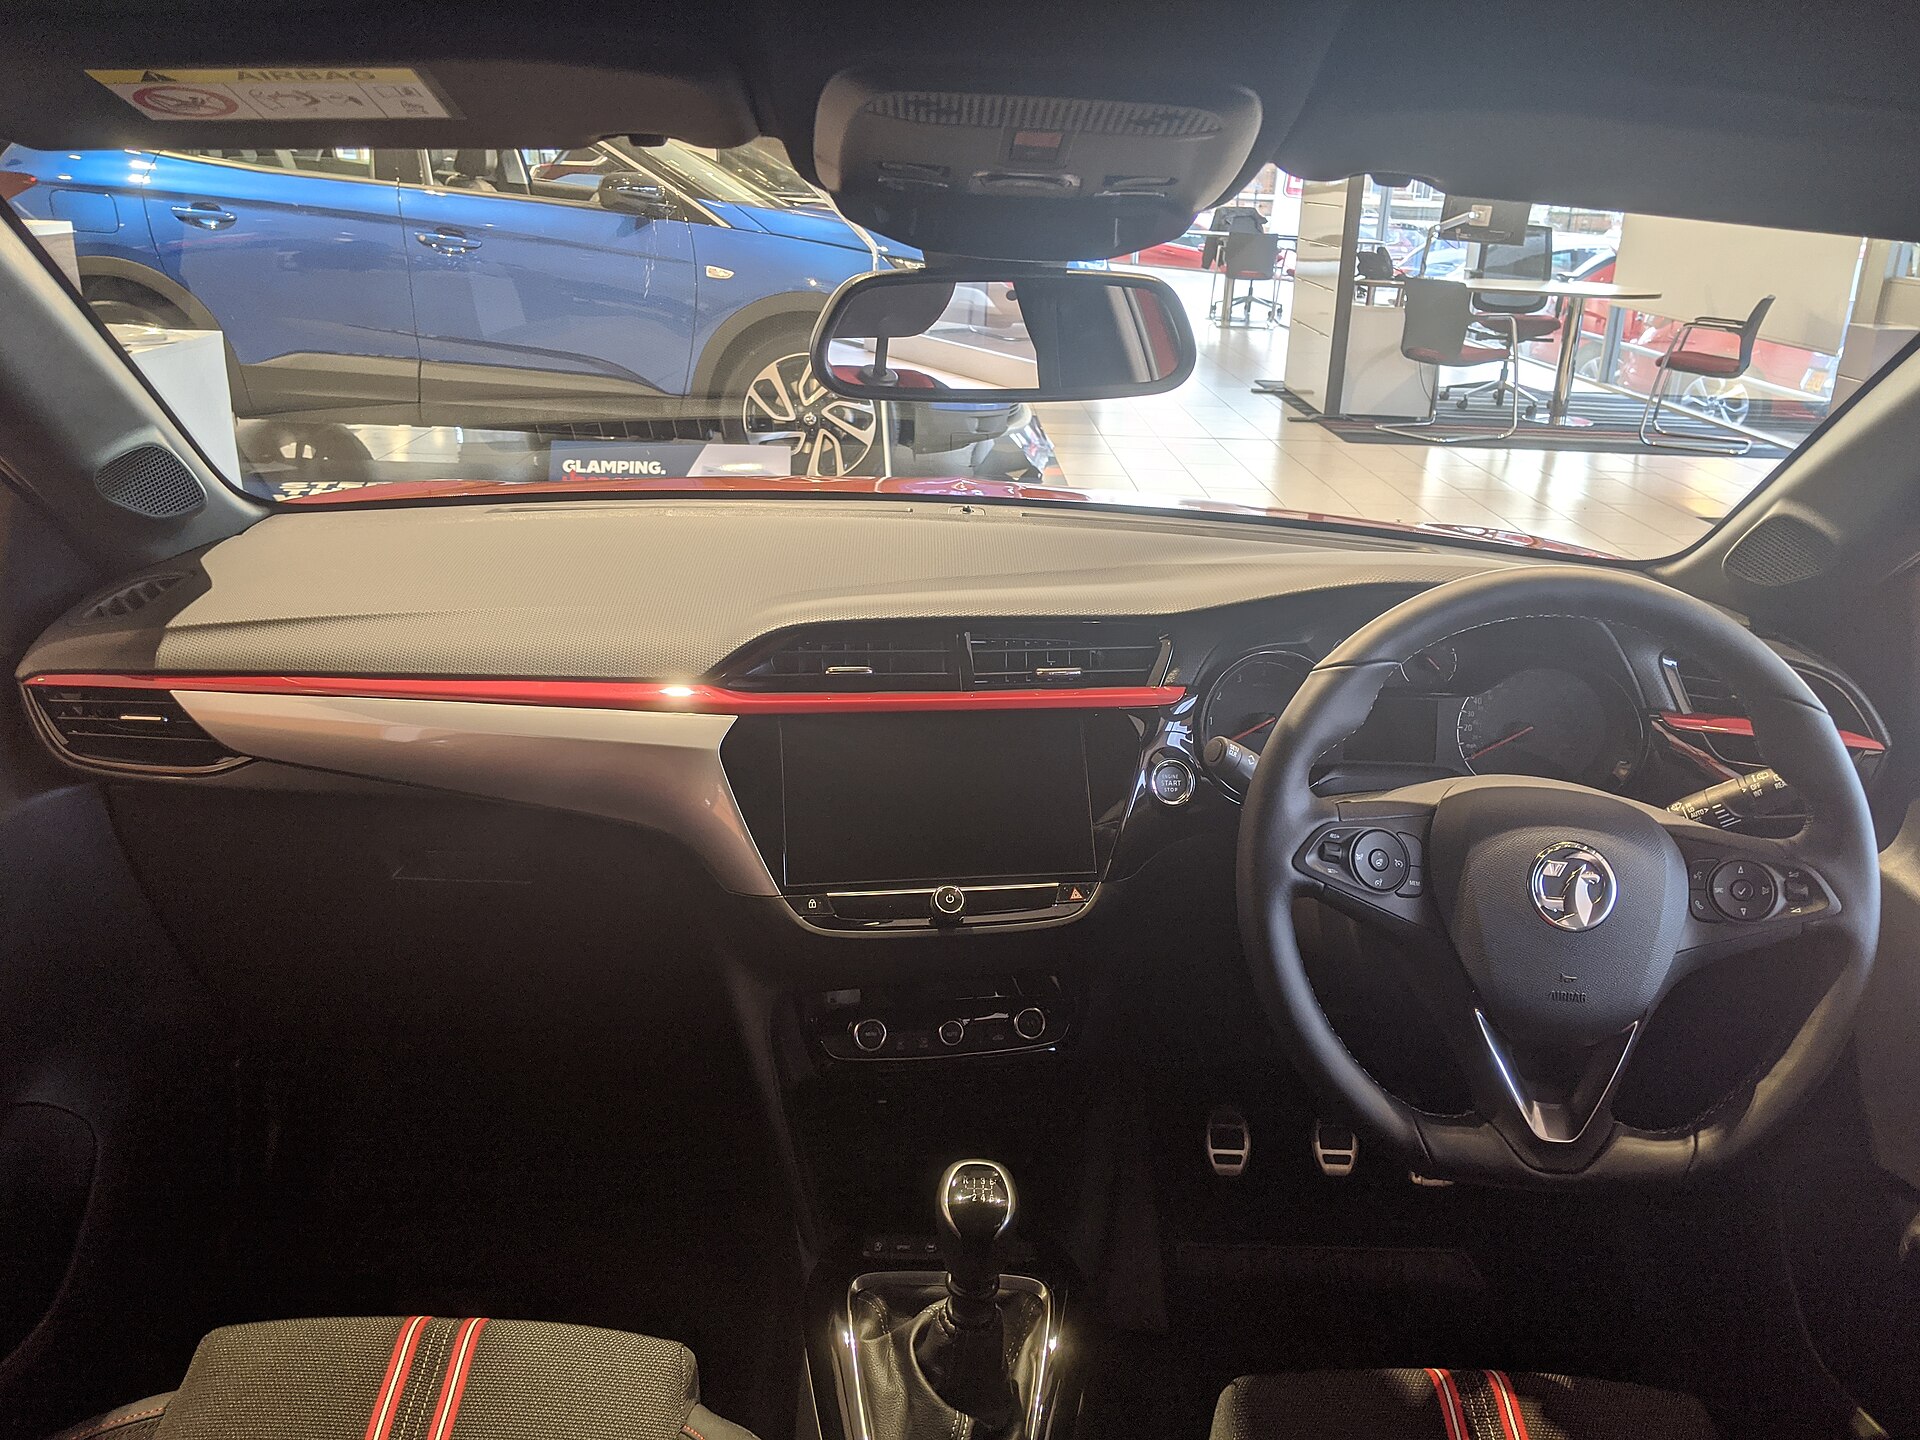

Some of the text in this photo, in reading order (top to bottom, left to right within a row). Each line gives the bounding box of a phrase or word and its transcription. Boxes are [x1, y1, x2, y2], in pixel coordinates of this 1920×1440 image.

[237, 70, 375, 82] AIRBAG
[562, 459, 667, 475] GLAMPING.
[1689, 808, 1705, 819] AUTO
[972, 1193, 977, 1202] 2
[980, 1194, 986, 1202] 4
